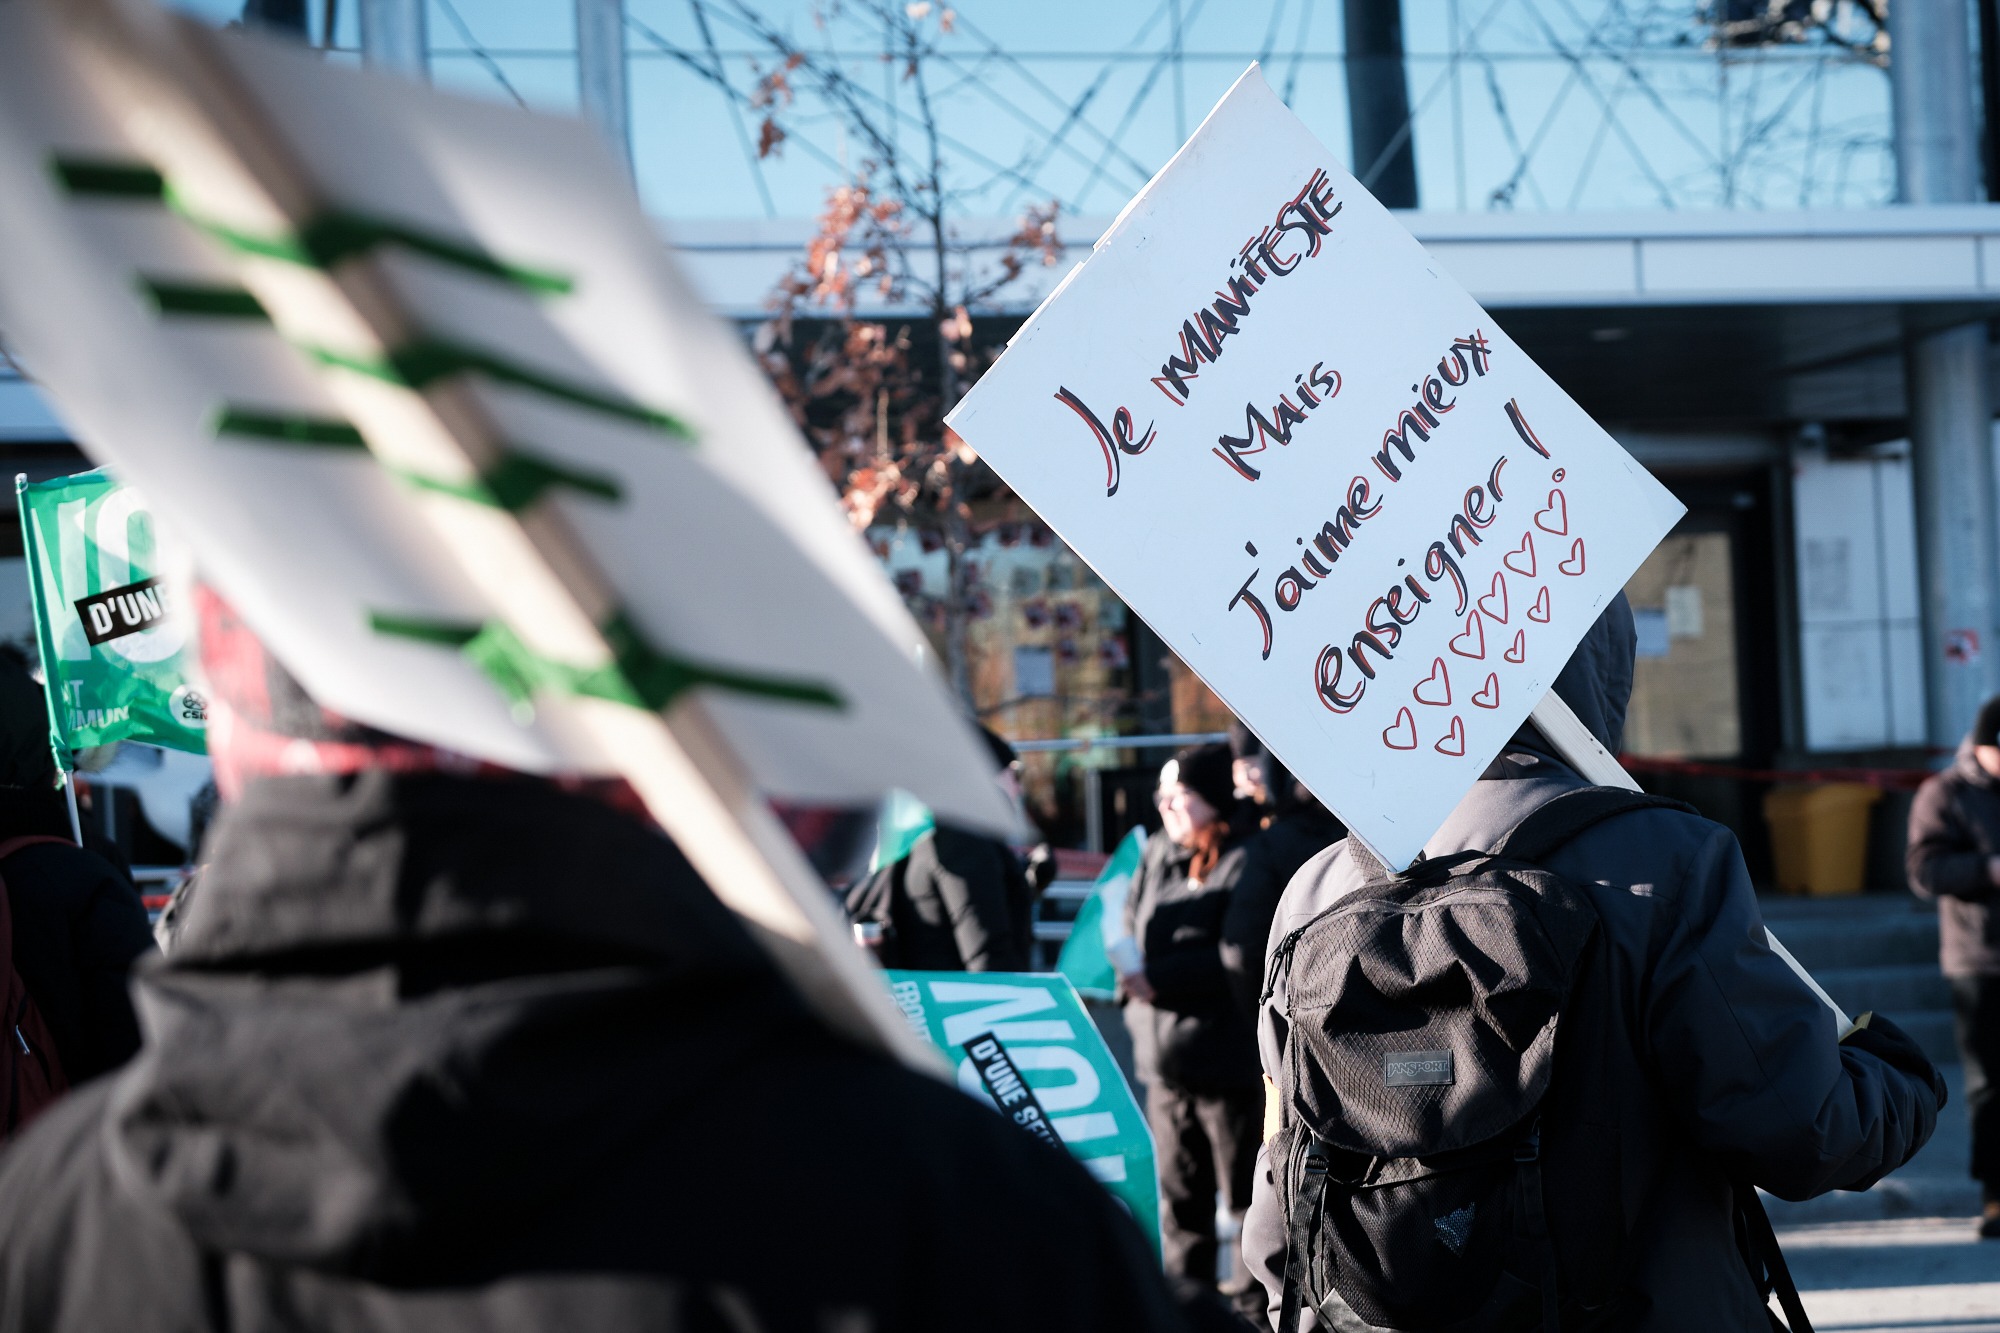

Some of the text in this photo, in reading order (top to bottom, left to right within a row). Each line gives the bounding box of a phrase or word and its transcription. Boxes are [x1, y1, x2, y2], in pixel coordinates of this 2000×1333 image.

[1053, 385, 1157, 498] Je
[970, 1038, 1028, 1107] D'UNE
[1388, 1061, 1448, 1078] JANSPORT
